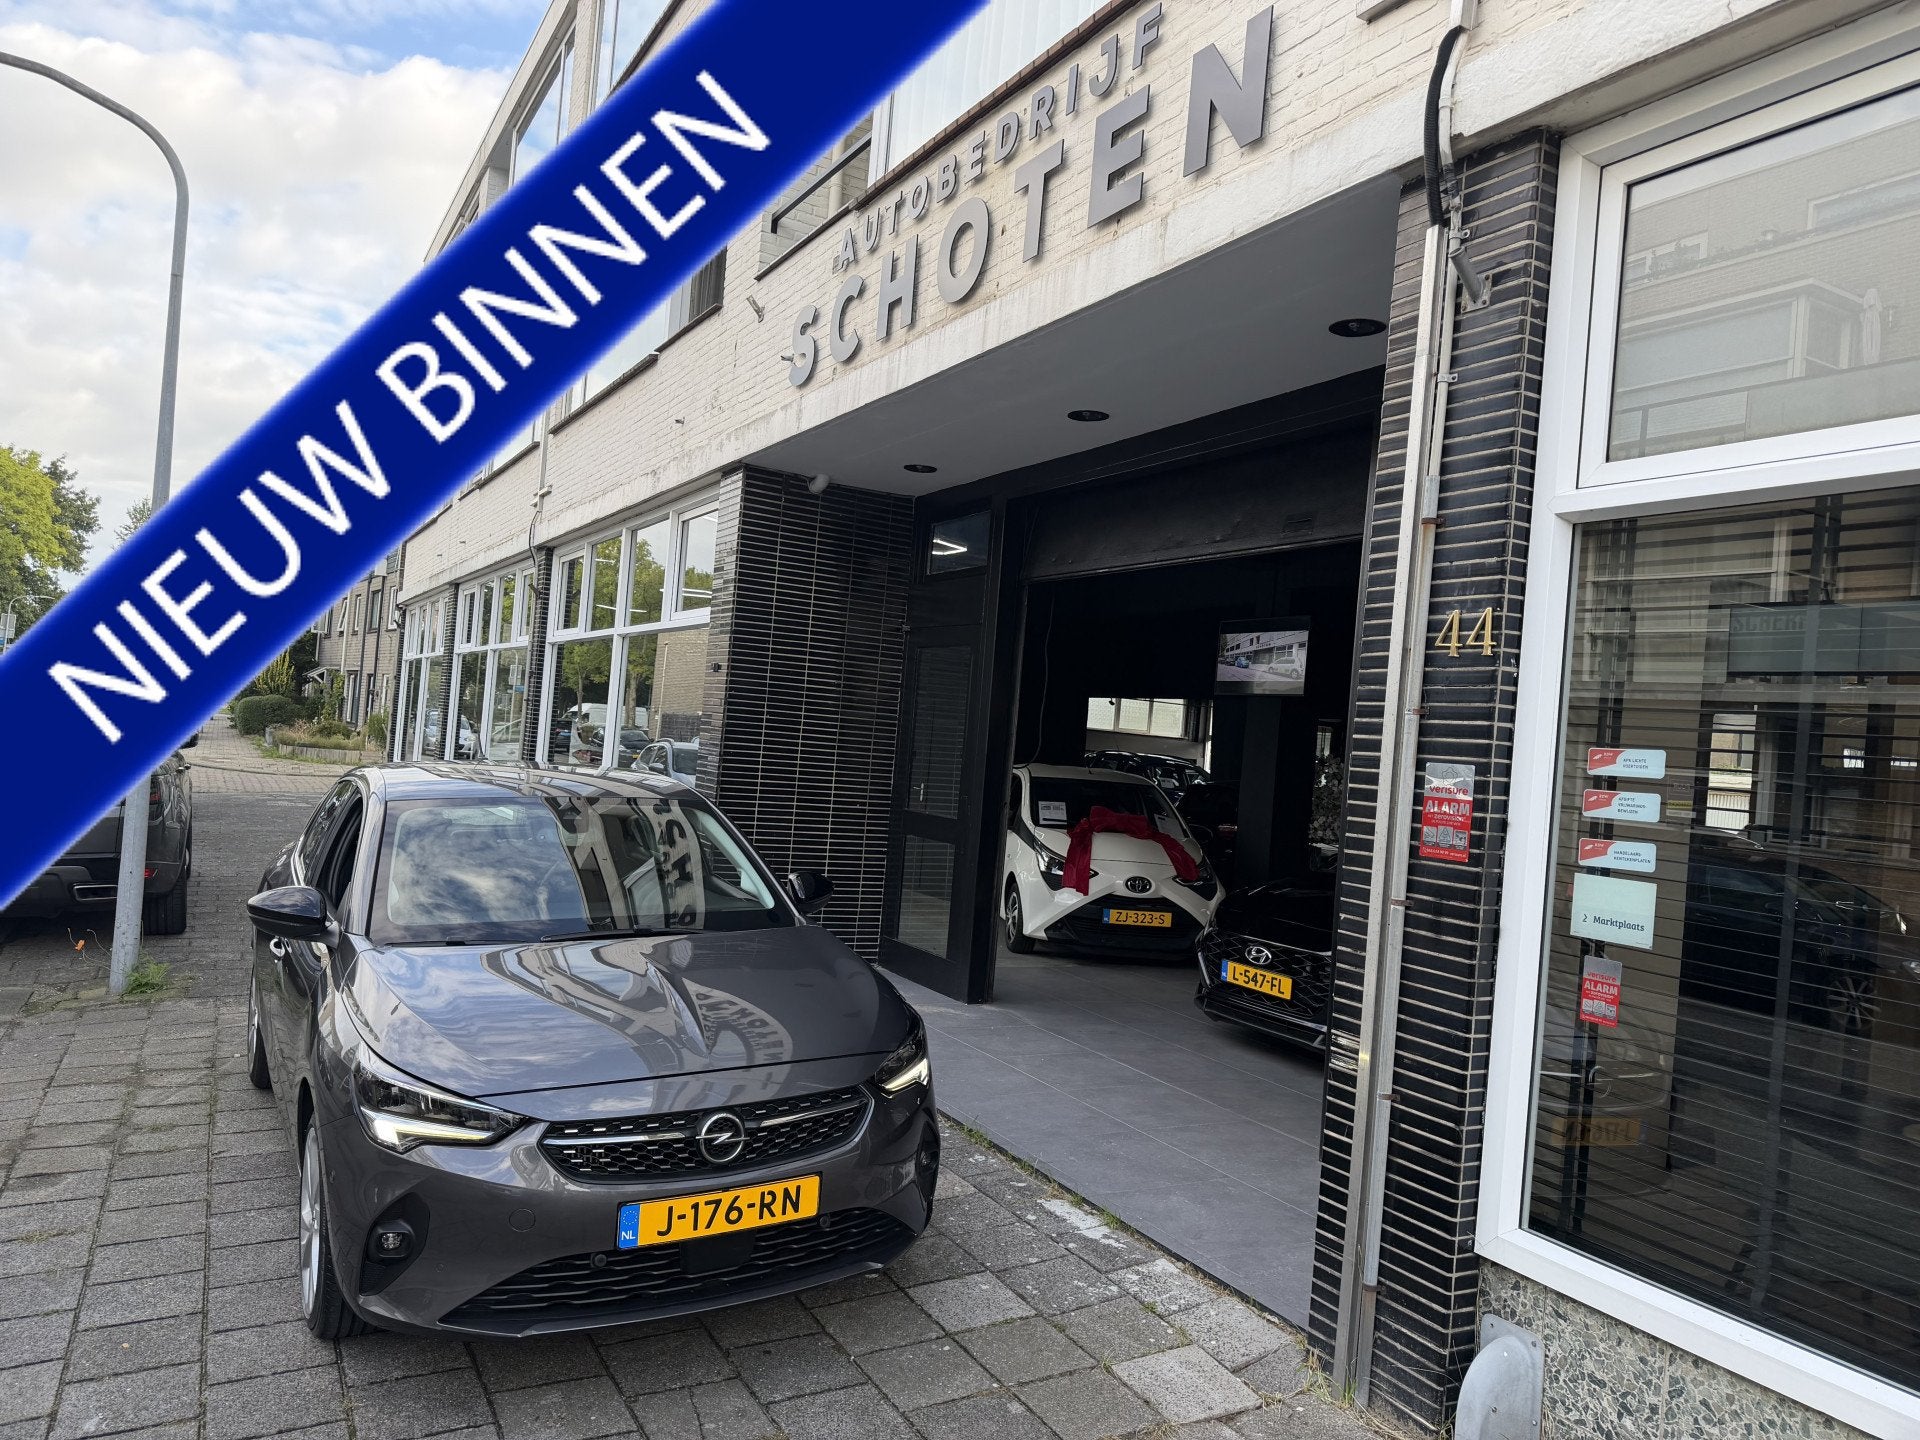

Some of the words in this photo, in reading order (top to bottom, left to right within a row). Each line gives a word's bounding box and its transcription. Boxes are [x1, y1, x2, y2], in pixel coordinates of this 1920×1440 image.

[835, 3, 1163, 272] AUTOBEDRIJF
[787, 5, 1274, 388] SCHOTEN
[1435, 607, 1497, 657] 44
[1429, 785, 1469, 796] verisure
[1425, 800, 1470, 816] ALARM
[1115, 911, 1165, 925] ZJ-323-S
[1593, 915, 1645, 932] Marktplaats
[1232, 965, 1285, 995] L-547-FL
[1584, 981, 1618, 996] ALARM
[621, 1230, 636, 1241] NL
[656, 1185, 802, 1237] J-176-RN
